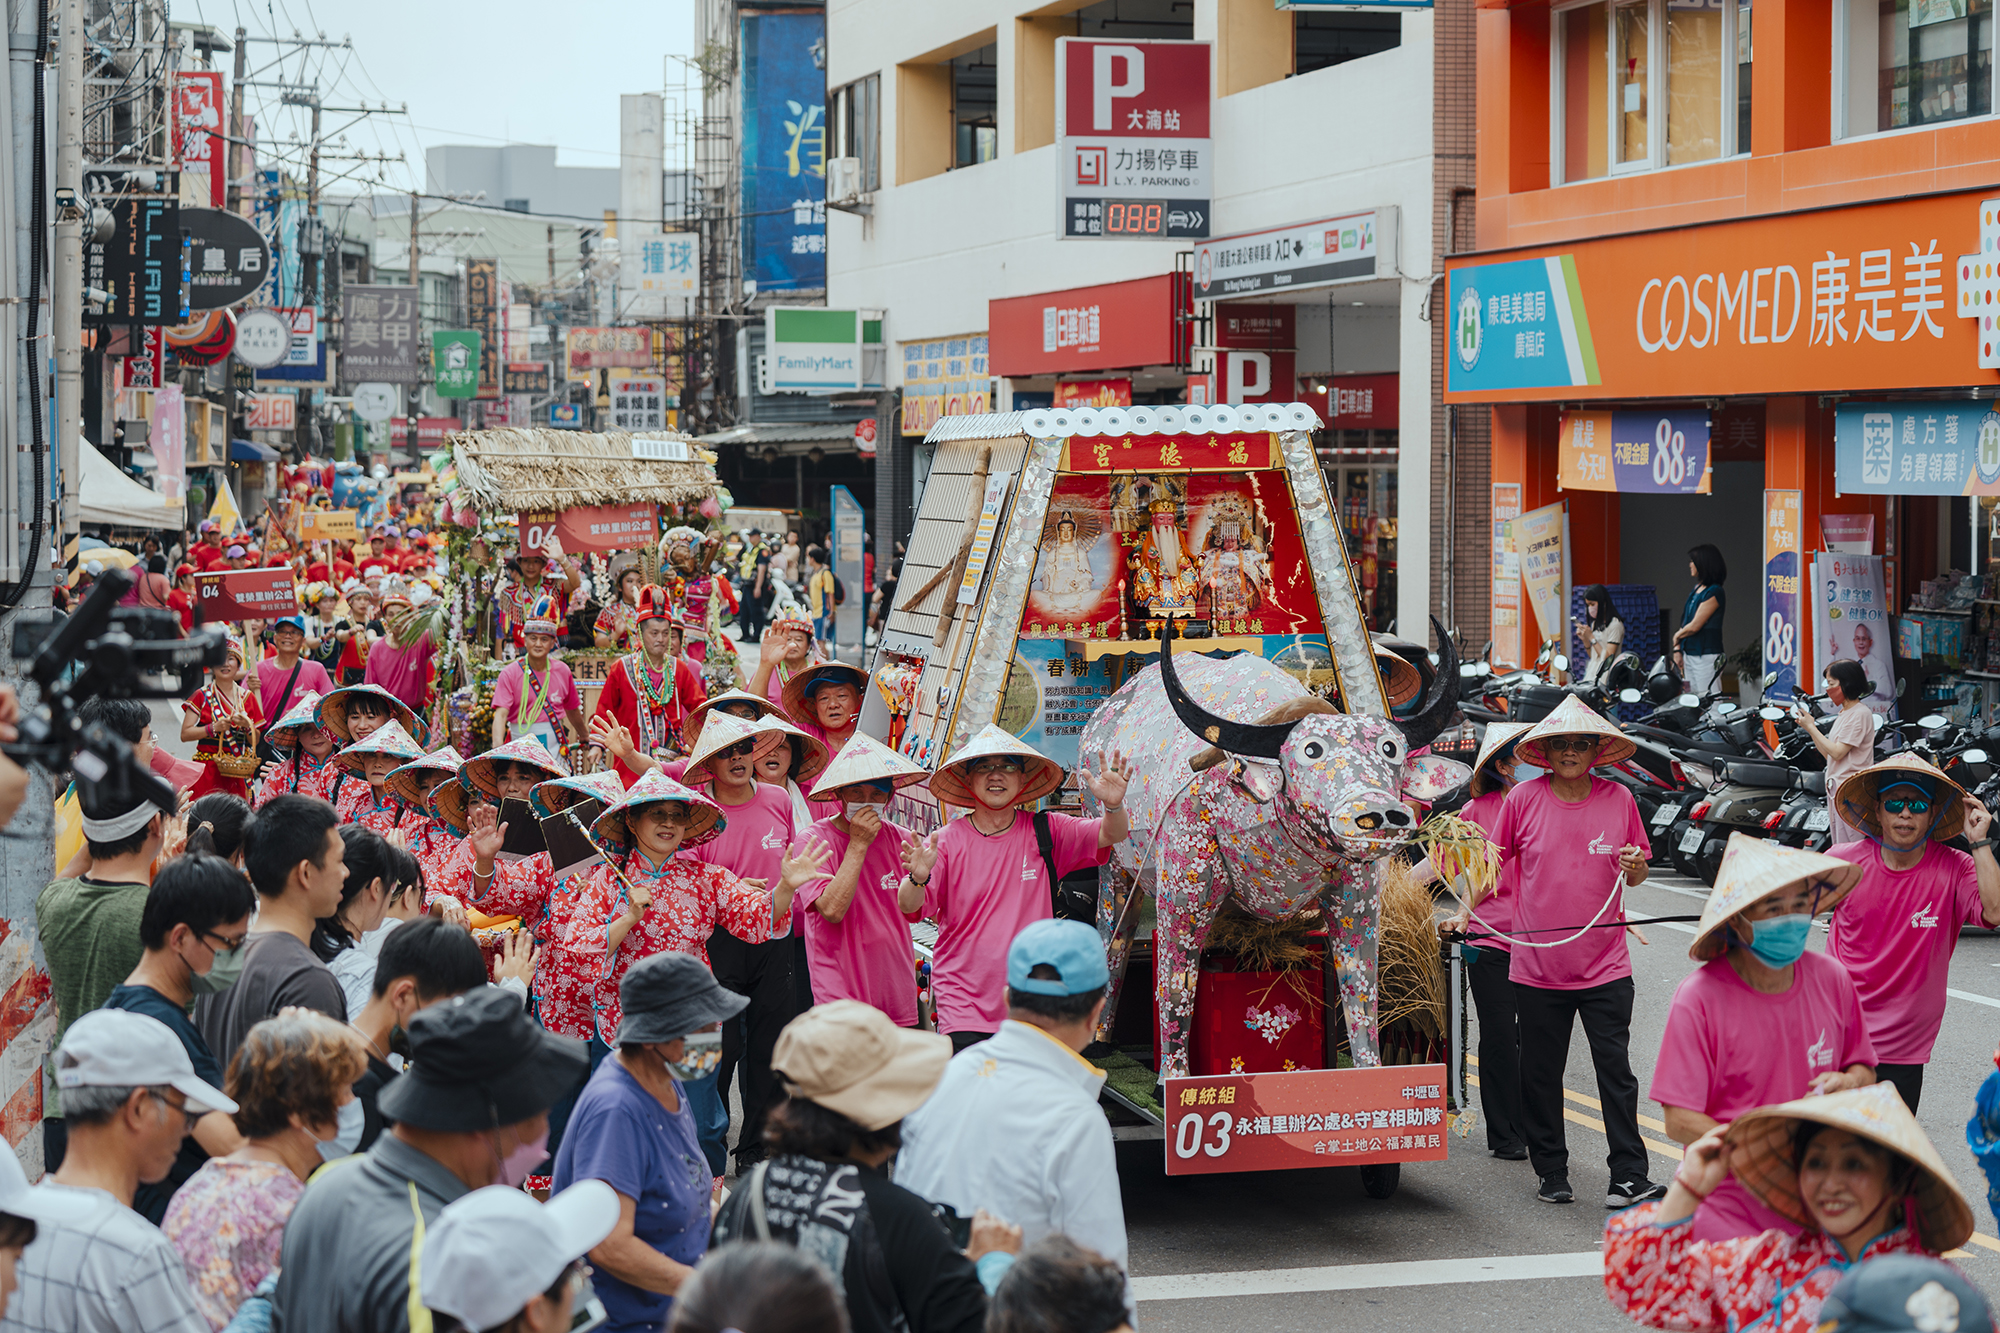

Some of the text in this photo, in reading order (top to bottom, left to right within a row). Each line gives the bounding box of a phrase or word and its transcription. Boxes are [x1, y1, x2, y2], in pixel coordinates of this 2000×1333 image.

[1093, 45, 1145, 130] P
[1127, 109, 1181, 131] 大湳站
[1115, 148, 1199, 171] 力揚停車
[1141, 177, 1191, 187] PARKING
[1107, 203, 1162, 233] 088
[144, 172, 165, 317] ILLIAM
[642, 240, 692, 274] 撞球
[1274, 238, 1291, 262] 入口
[203, 247, 262, 271] 皇后
[349, 293, 412, 320] 魔力
[1488, 291, 1546, 326] 康是美藥局
[1636, 239, 1944, 353] COSMED 康是美
[349, 321, 411, 348] 美甲
[1514, 330, 1546, 359] 廣福店
[346, 355, 378, 366] MOLI
[777, 355, 853, 371] FamilyMart
[248, 398, 292, 428] 刻印
[1572, 419, 1595, 448] 就是
[1902, 415, 1959, 445] 處方箋
[1614, 442, 1650, 466] 不限金額
[1899, 452, 1958, 483] 免費領藥
[1769, 509, 1785, 527] 就是
[202, 585, 219, 598] 04
[1030, 622, 1109, 639] 觀世音菩薩
[1207, 617, 1265, 634] 祖娘娘
[1767, 612, 1794, 665] 88
[1180, 1086, 1236, 1106] 傳統組
[1401, 1085, 1441, 1100] 中壢區
[1236, 1107, 1443, 1135] 永福里辦公處&守望相助隊
[1175, 1111, 1233, 1159] 03
[1314, 1134, 1441, 1155] 合掌土地公 福澤萬民
